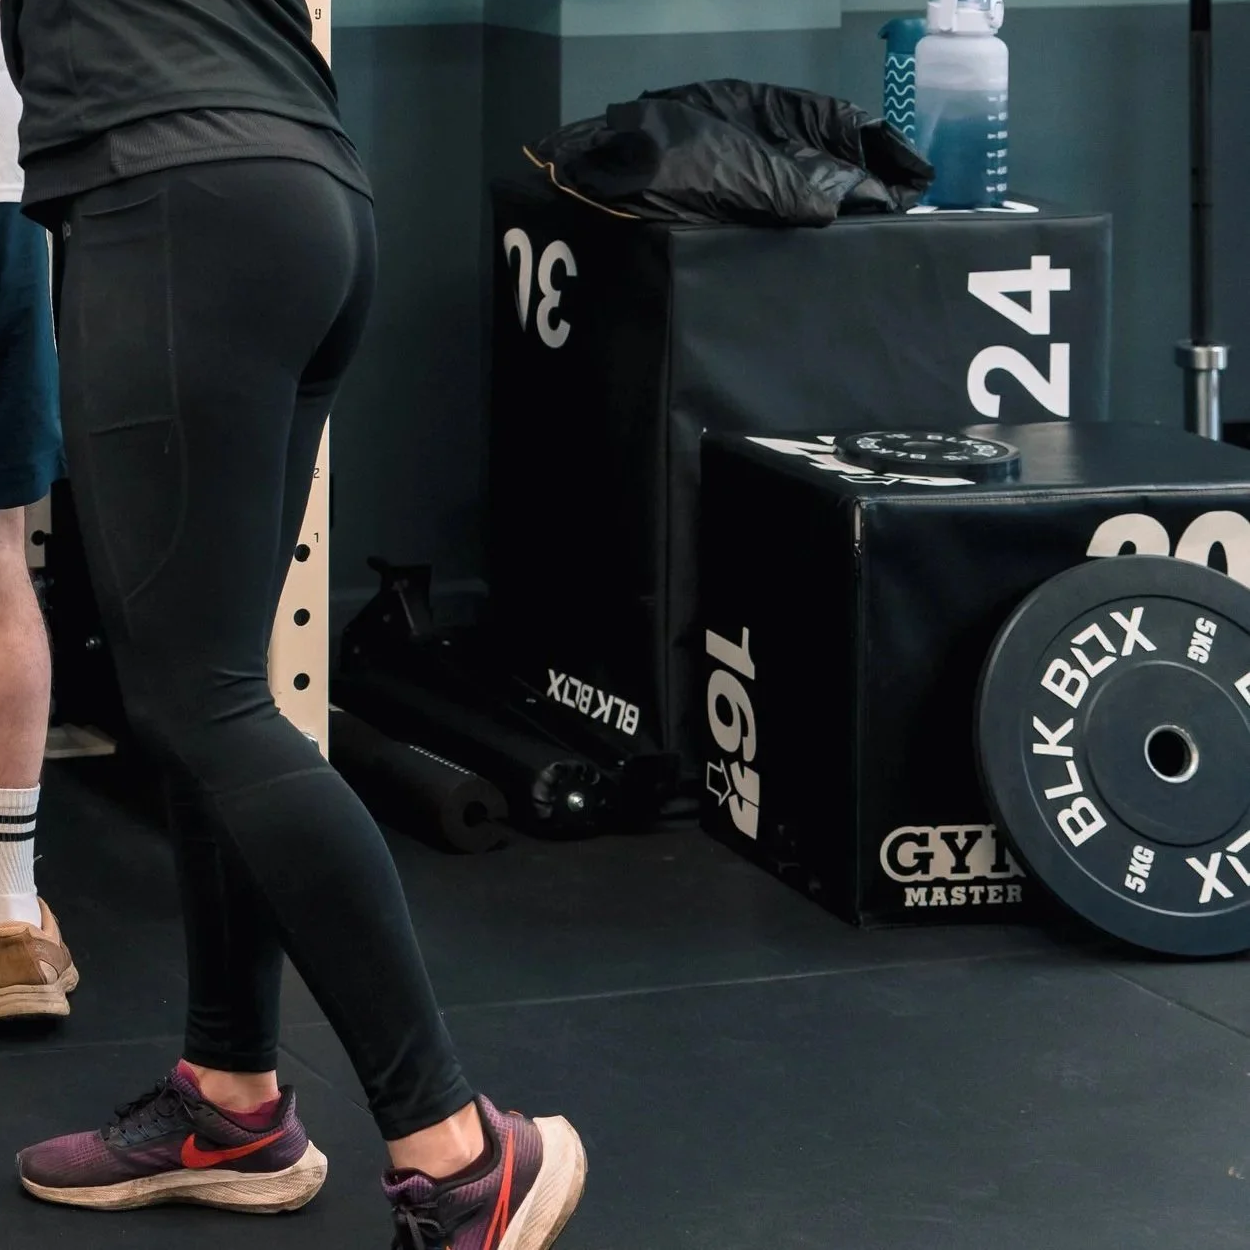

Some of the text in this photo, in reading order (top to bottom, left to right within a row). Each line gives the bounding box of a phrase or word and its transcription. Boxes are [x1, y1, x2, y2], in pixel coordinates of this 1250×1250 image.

[967, 255, 1071, 419] 24
[1187, 617, 1218, 664] 5KG
[546, 668, 640, 736] BLK BOX
[1032, 607, 1158, 847] BLK BOX
[904, 885, 1023, 907] MASTER
[1125, 845, 1155, 894] 5KG
